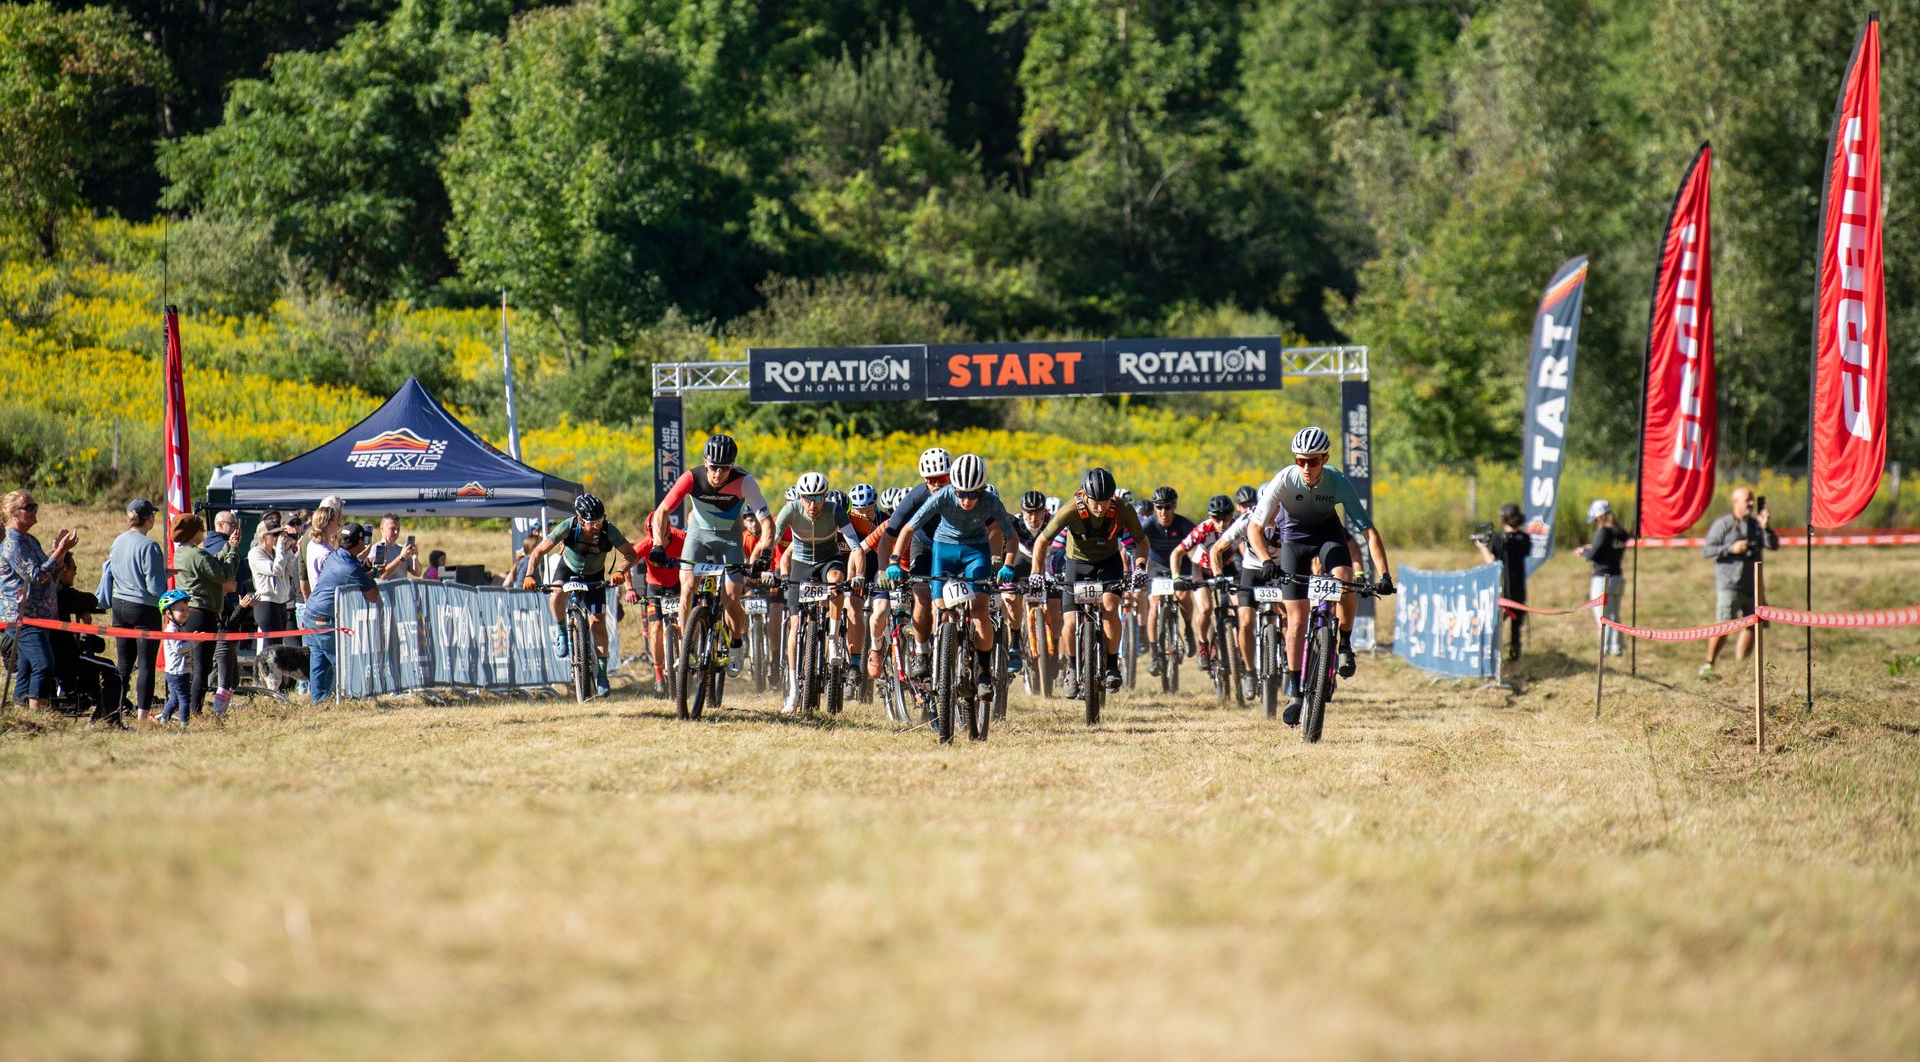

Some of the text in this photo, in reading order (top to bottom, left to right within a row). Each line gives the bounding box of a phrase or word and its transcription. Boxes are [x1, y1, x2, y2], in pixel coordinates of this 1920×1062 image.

[948, 352, 1082, 388] START
[1119, 346, 1266, 384] ROTATION
[765, 356, 910, 393] ROTATION
[1148, 373, 1267, 384] ENGINEERING
[794, 383, 910, 393] ENGINEERING
[1530, 313, 1573, 509] START
[662, 427, 671, 449] DAY
[670, 420, 679, 450] RACE
[389, 453, 442, 468] XC
[662, 449, 680, 481] XC
[1315, 494, 1335, 503] RHC
[804, 586, 824, 598] 266
[948, 582, 969, 600] 178
[1083, 585, 1095, 598] 18
[1259, 589, 1278, 598] 335
[1314, 580, 1337, 595] 344
